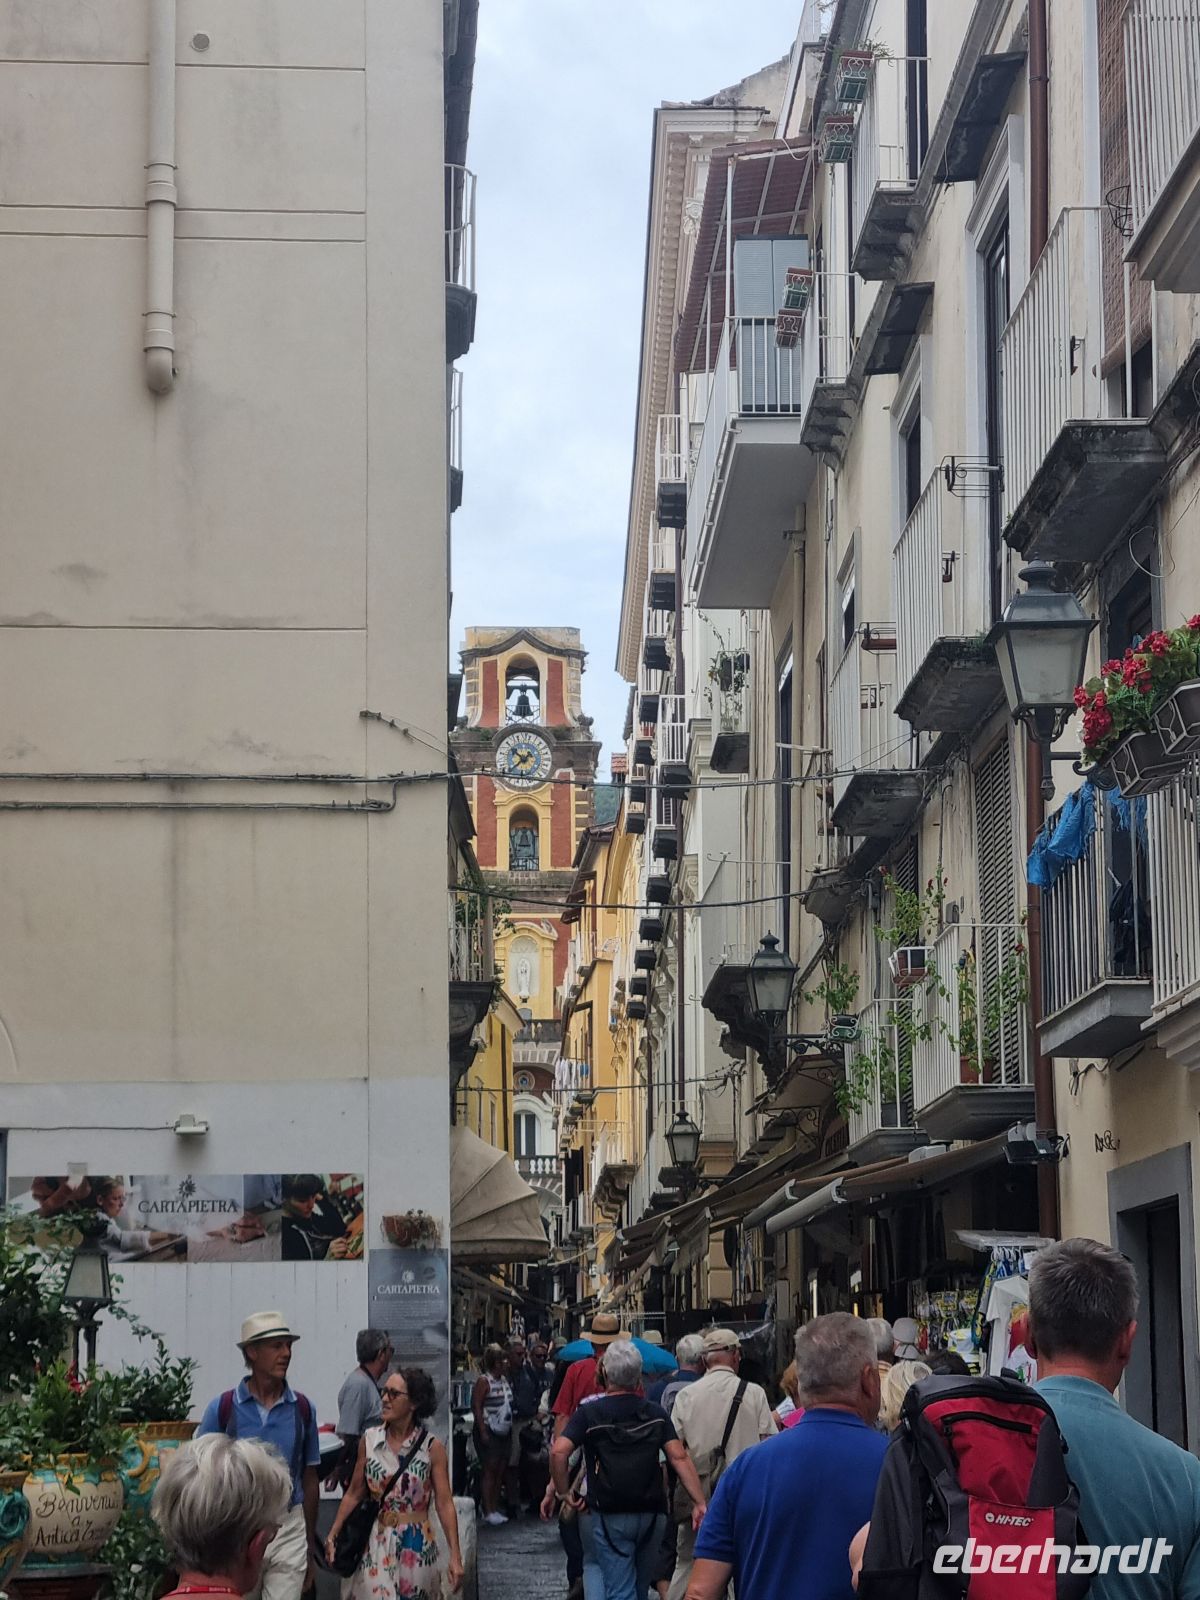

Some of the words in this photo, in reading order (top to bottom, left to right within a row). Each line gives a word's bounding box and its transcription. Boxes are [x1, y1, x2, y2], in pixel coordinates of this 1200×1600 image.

[138, 1199, 237, 1213] CARTAPIETRA
[377, 1285, 440, 1294] CARTAPIETRA
[995, 1514, 1032, 1527] HI-TEC
